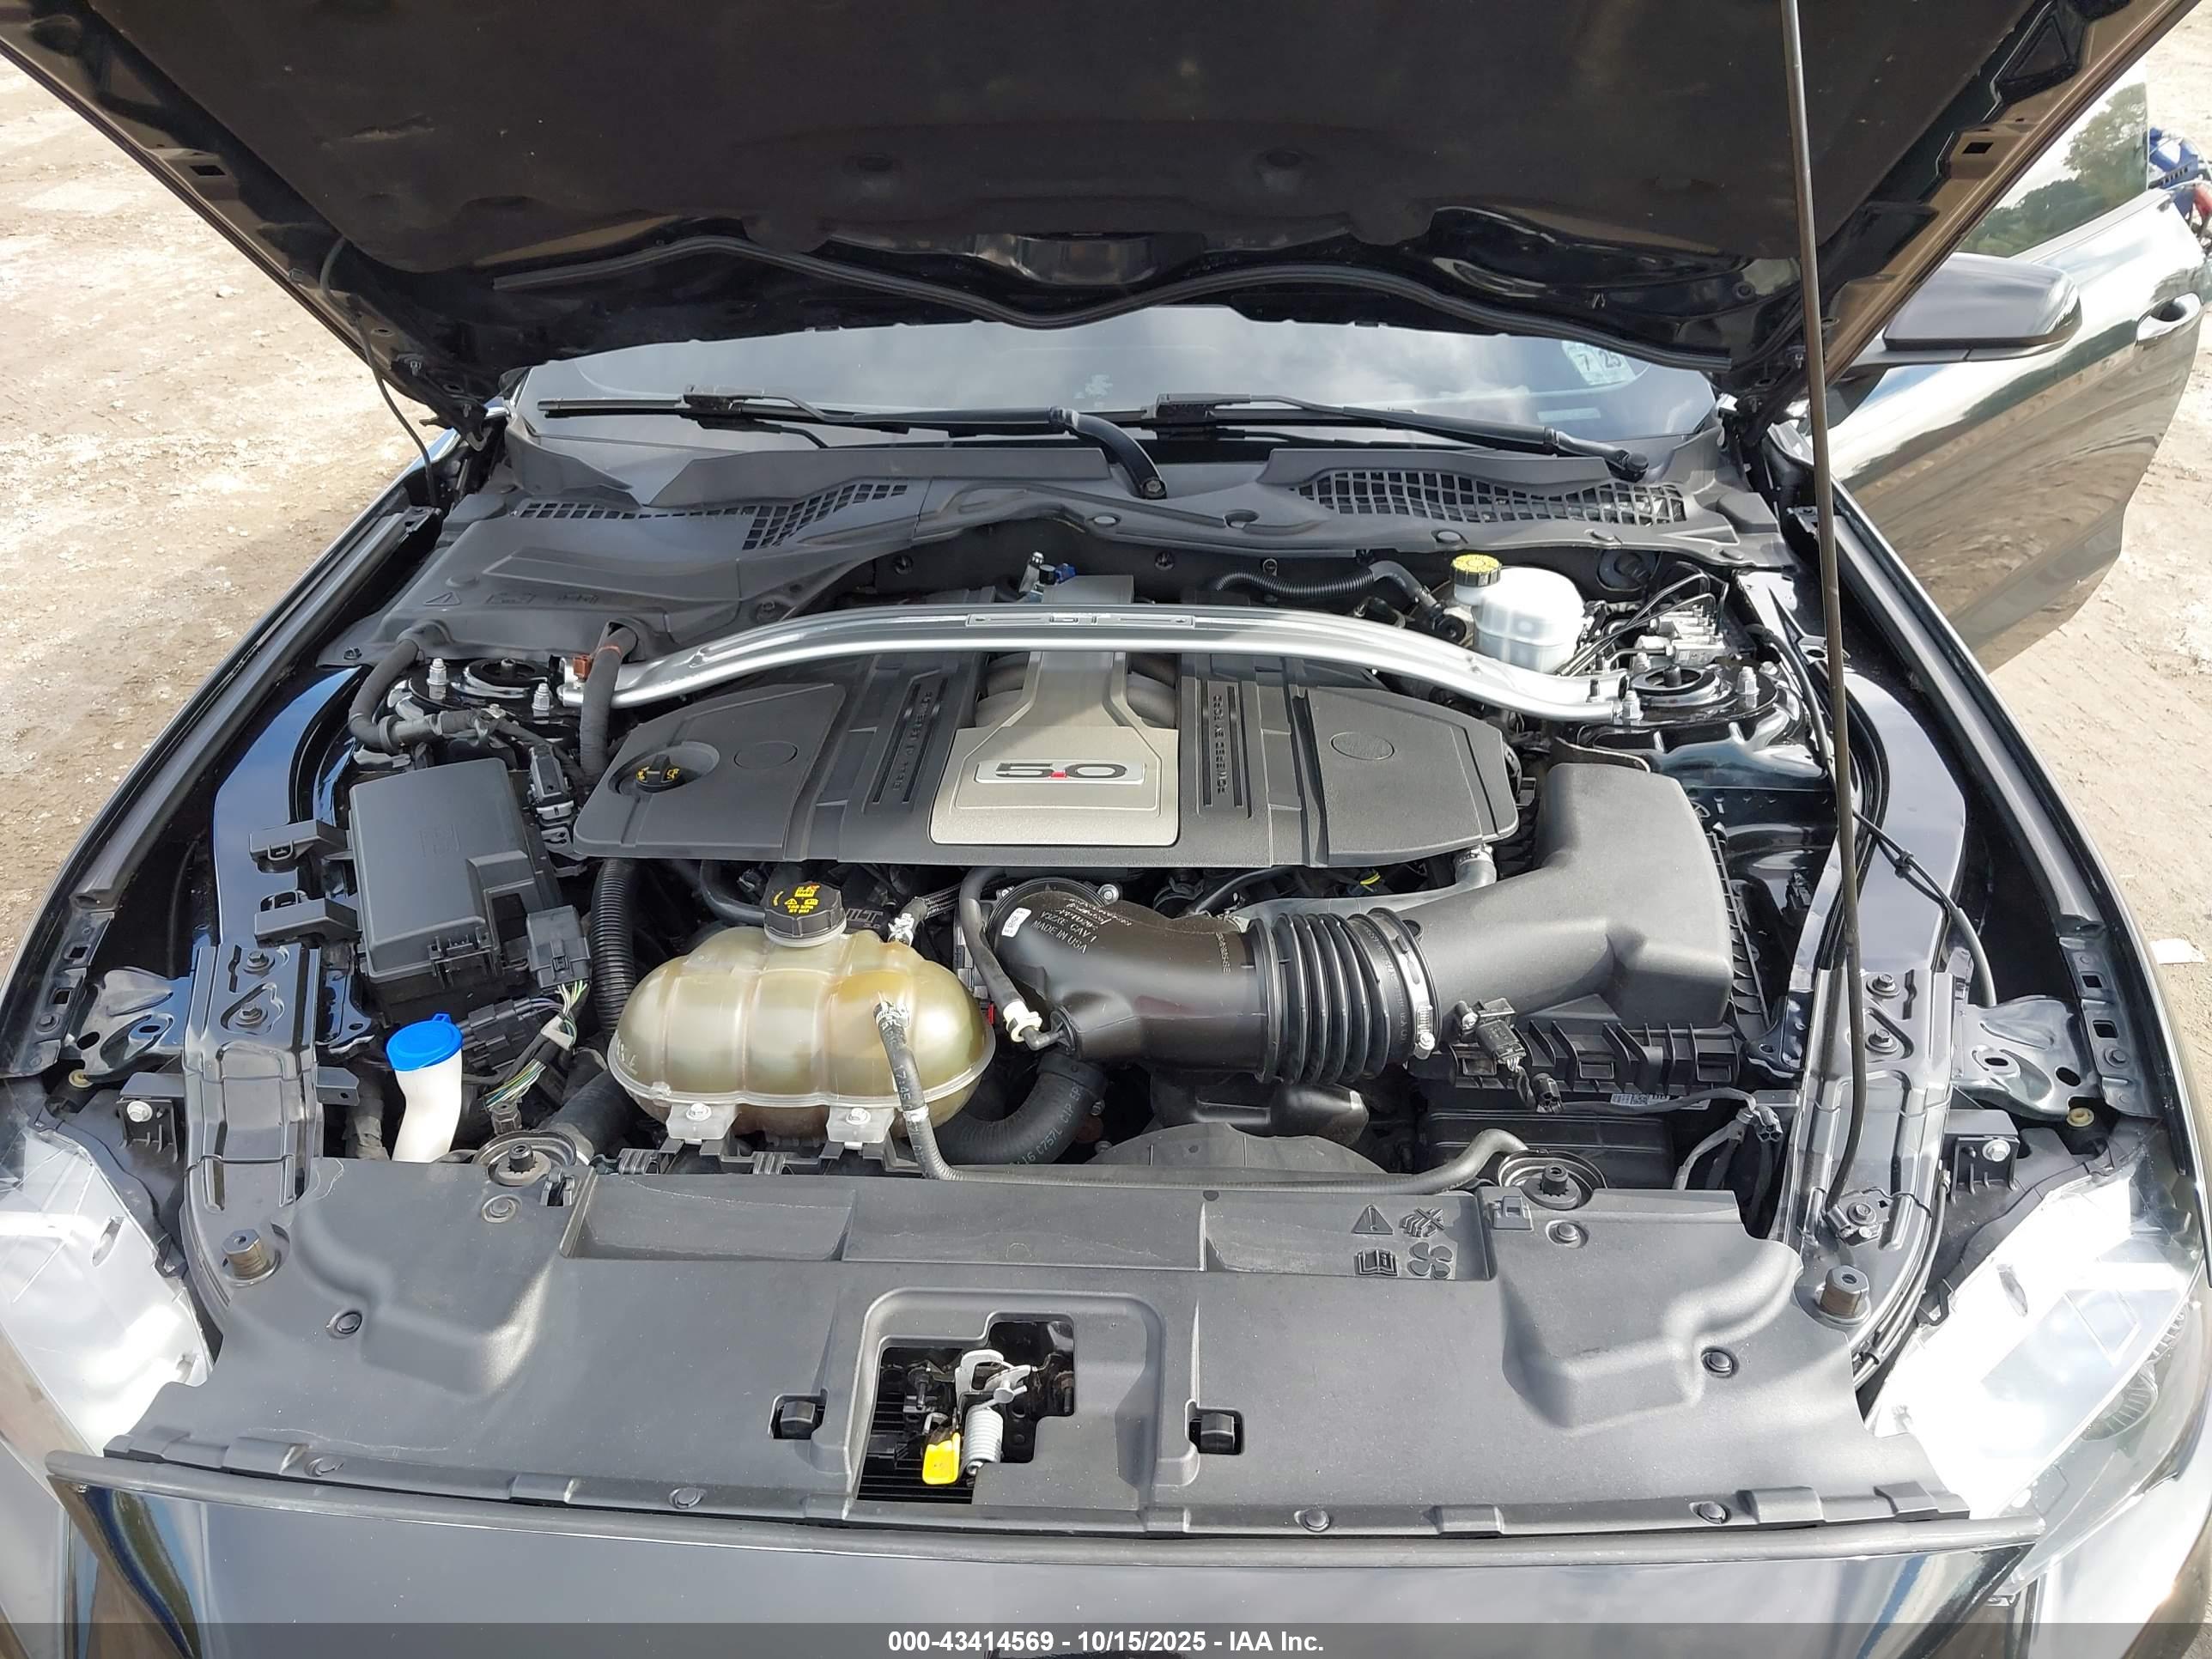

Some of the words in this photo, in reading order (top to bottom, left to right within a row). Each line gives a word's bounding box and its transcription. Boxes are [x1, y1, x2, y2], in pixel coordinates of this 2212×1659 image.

[1598, 349, 1622, 368] 25
[995, 763, 1128, 779] 5.0
[1030, 919, 1058, 936] MADE
[1056, 928, 1069, 942] IN
[1066, 935, 1089, 955] USA
